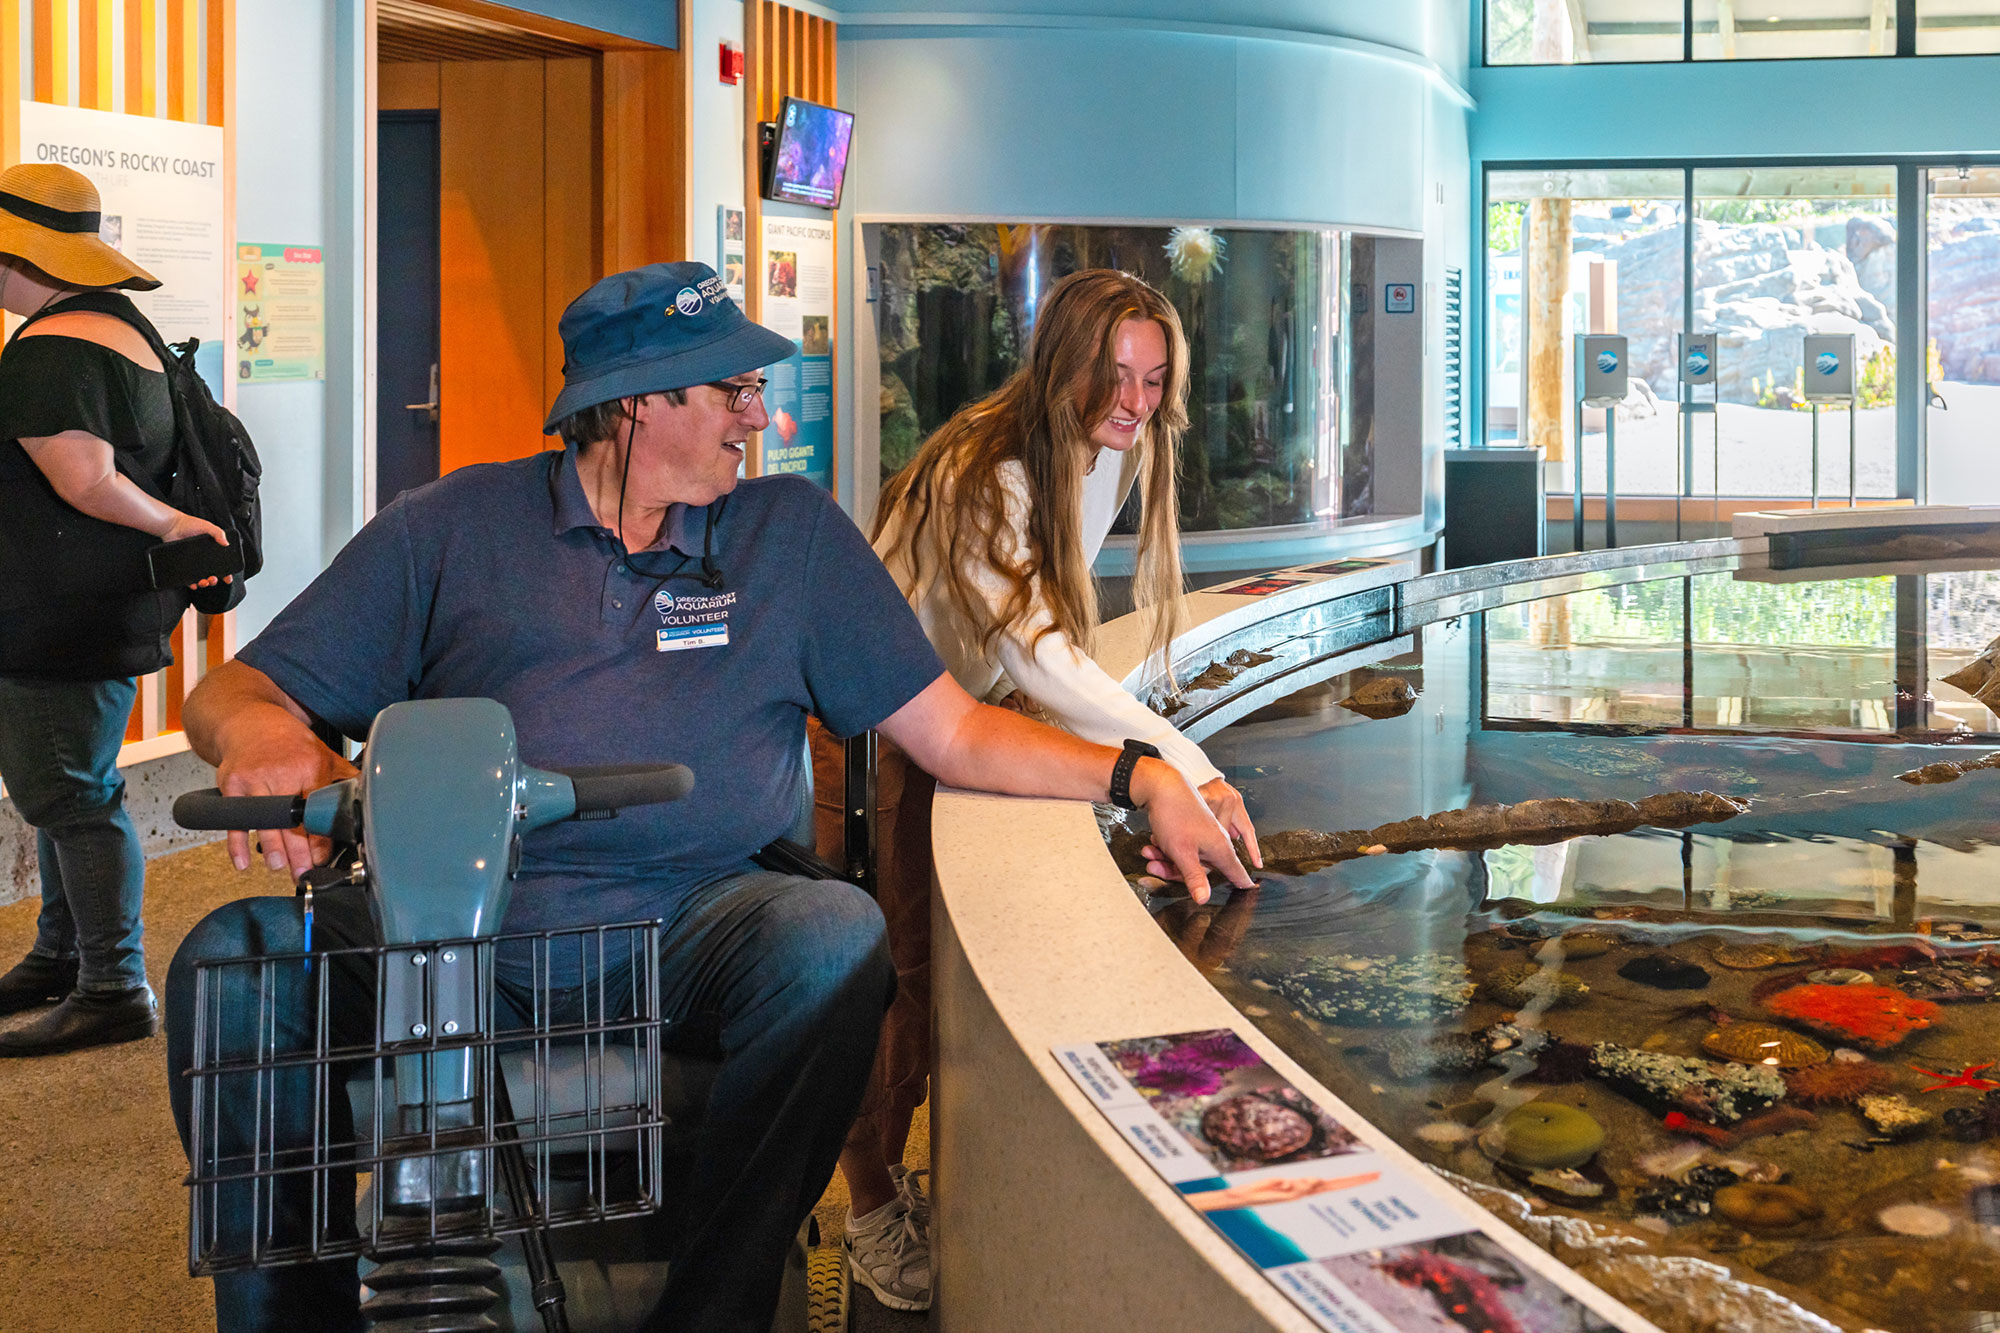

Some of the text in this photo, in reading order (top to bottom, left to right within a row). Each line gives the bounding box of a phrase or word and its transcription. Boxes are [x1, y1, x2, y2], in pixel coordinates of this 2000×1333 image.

[37, 143, 215, 178] OREGON'S ROCKY COAST
[768, 223, 831, 240] GIANT PACIFIC OCTOPUS
[767, 445, 814, 461] PULPO GIGANTE
[675, 597, 737, 611] AQUARIUM
[709, 592, 736, 601] COAST
[661, 610, 729, 625] VOLUNTEER
[691, 627, 725, 635] VOLUNTEER
